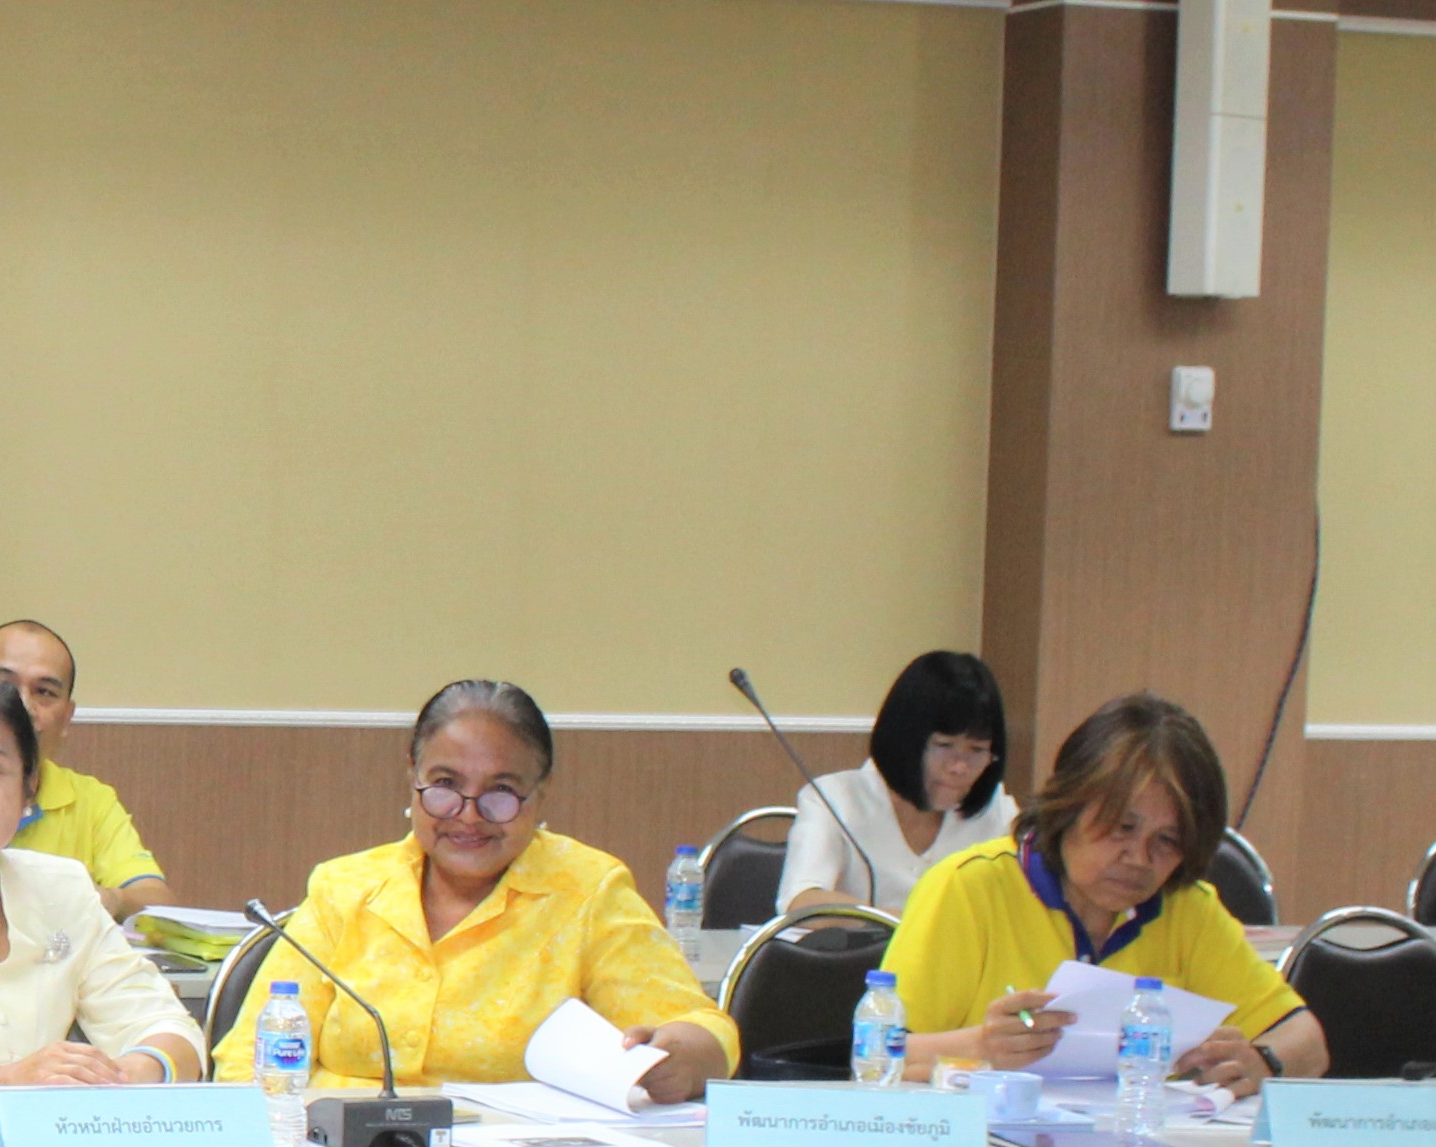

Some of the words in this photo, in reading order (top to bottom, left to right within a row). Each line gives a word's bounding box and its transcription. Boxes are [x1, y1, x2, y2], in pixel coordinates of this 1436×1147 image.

[55, 1115, 223, 1135] หัวหน้าฝ่ายอำนวยการ
[737, 1110, 952, 1142] พัฒนาการอำเภอเมืองชัยภูมิ
